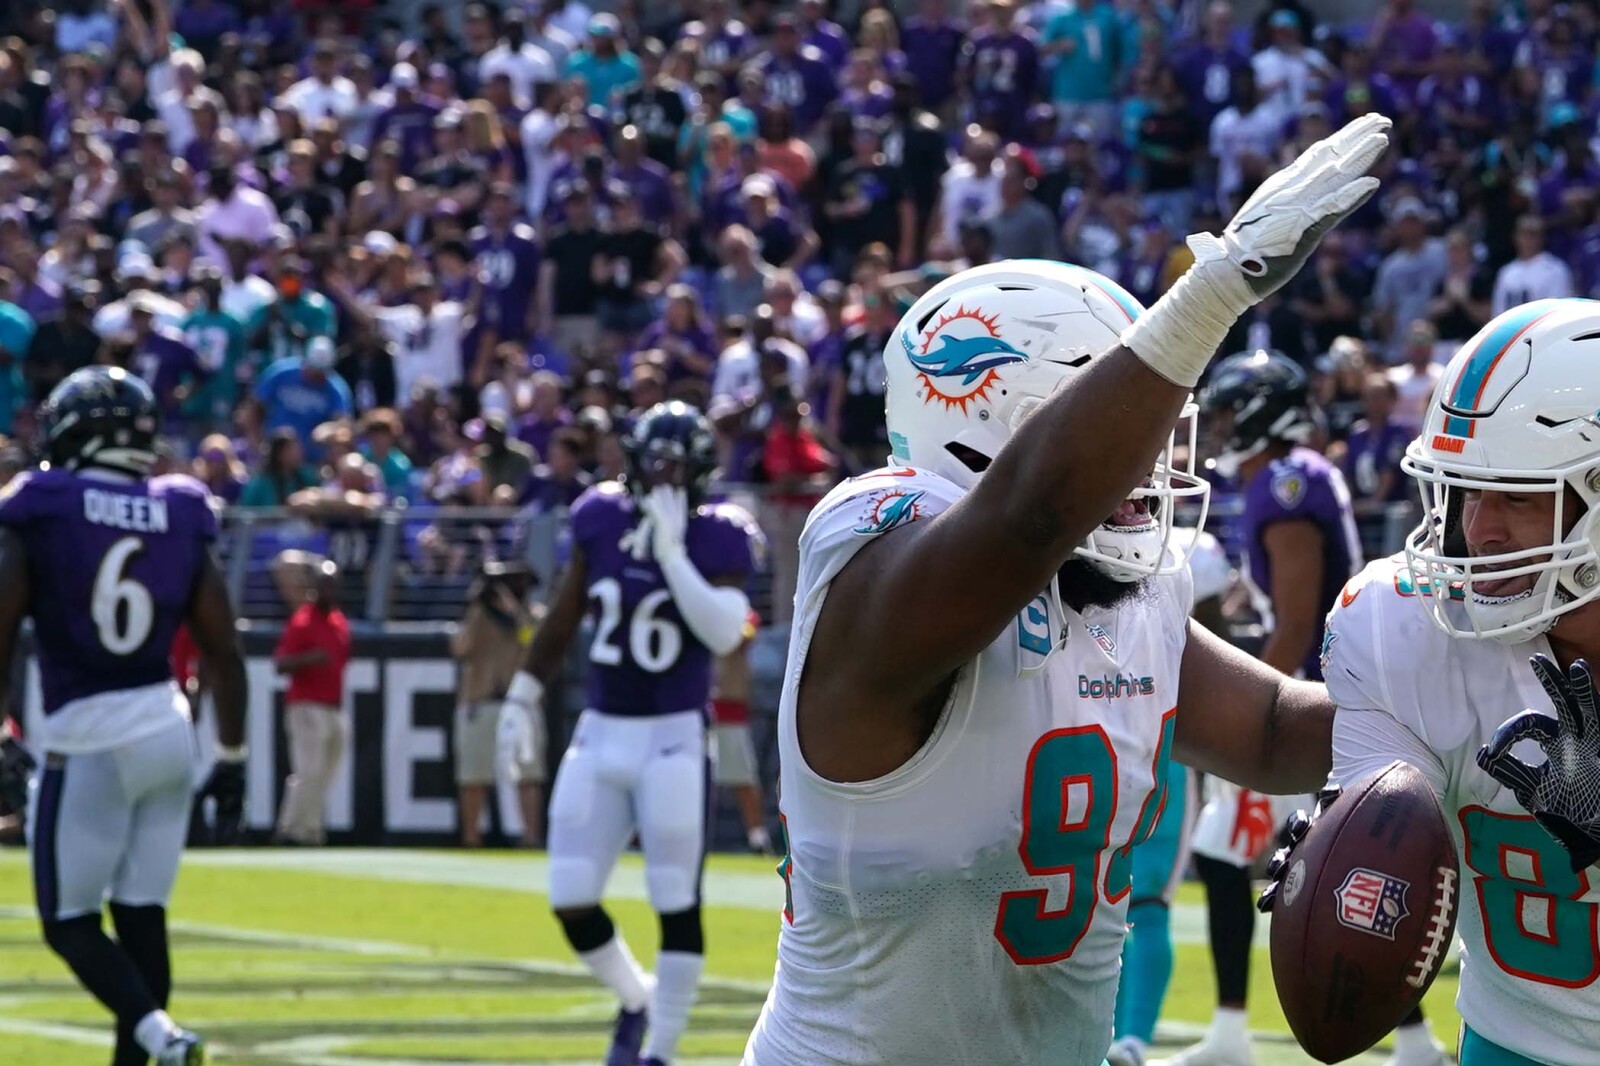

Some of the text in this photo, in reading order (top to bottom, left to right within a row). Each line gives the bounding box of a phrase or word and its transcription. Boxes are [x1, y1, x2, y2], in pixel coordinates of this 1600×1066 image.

[1431, 435, 1466, 455] MIAMI
[83, 487, 169, 534] QUEEN
[90, 536, 154, 656] 6
[1020, 596, 1050, 640] C
[587, 577, 682, 673] 26
[1078, 672, 1156, 704] Dolphins
[1343, 872, 1384, 922] NFL
